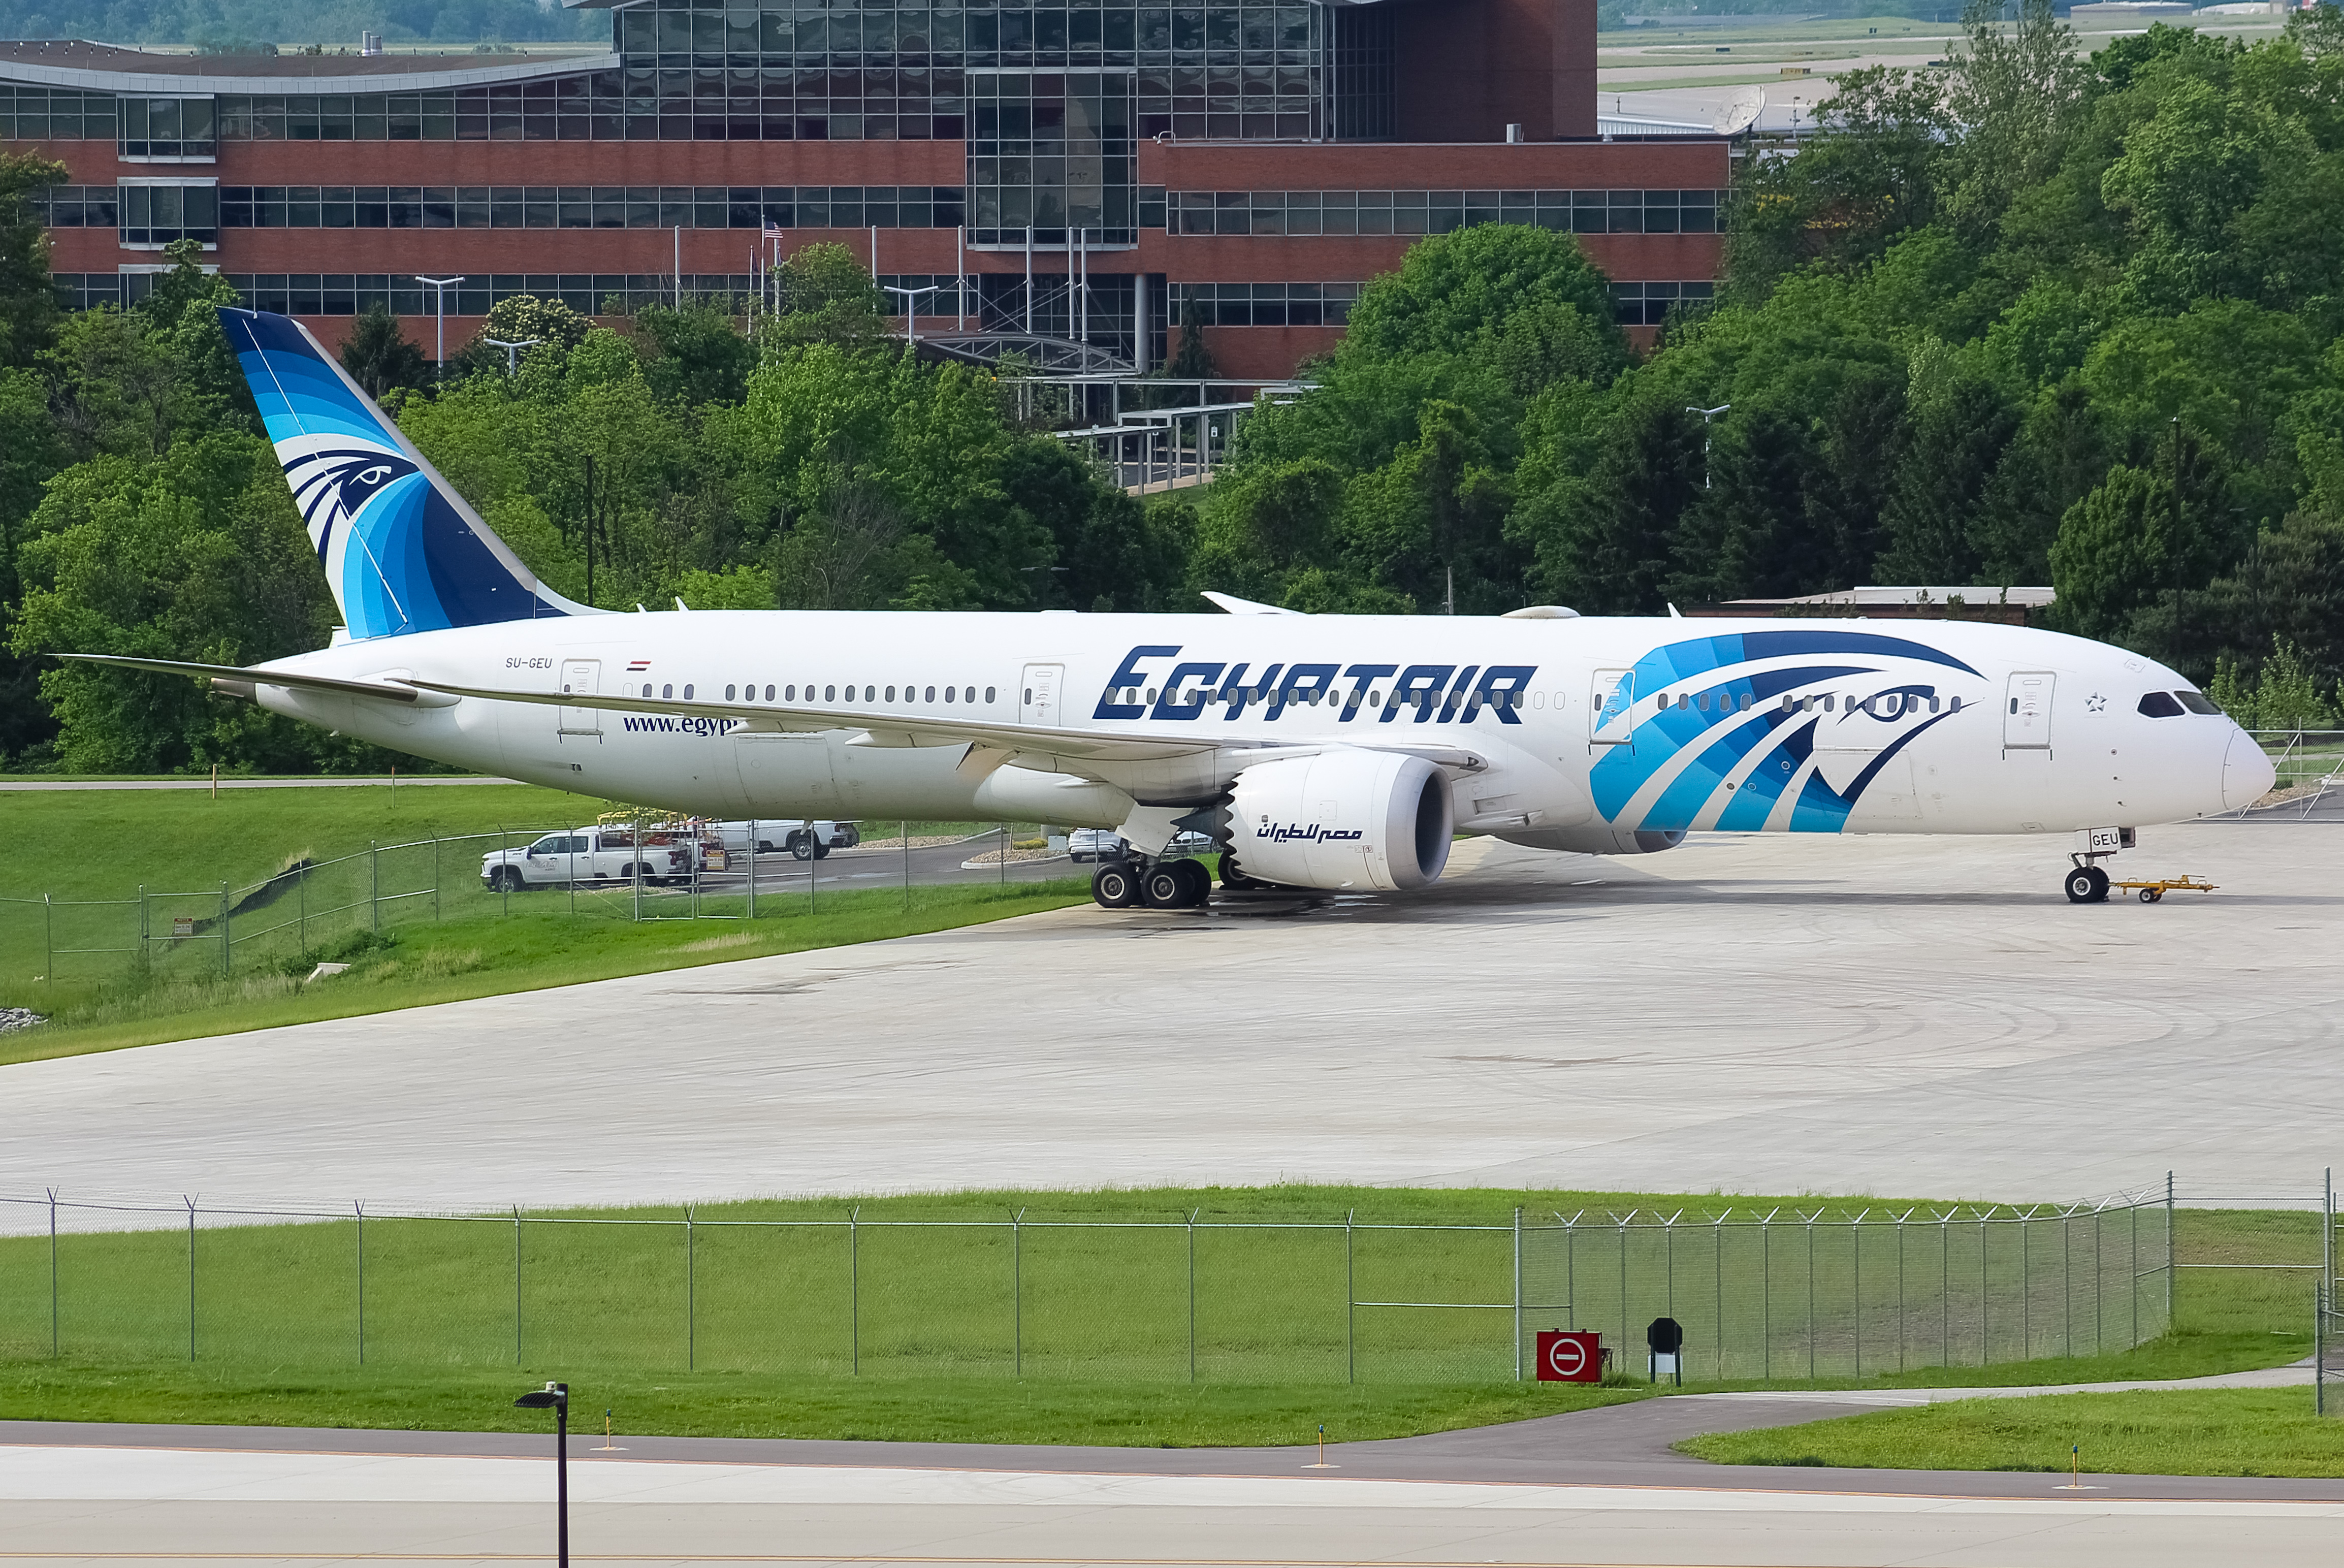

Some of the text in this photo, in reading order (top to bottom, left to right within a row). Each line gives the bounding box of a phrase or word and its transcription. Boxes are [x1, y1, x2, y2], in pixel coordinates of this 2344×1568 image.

[505, 657, 553, 669] SU-GEU
[1092, 645, 1538, 724] EGYPTAIR
[1257, 822, 1363, 844] مصر للطيران
[2092, 833, 2119, 846] GEU
